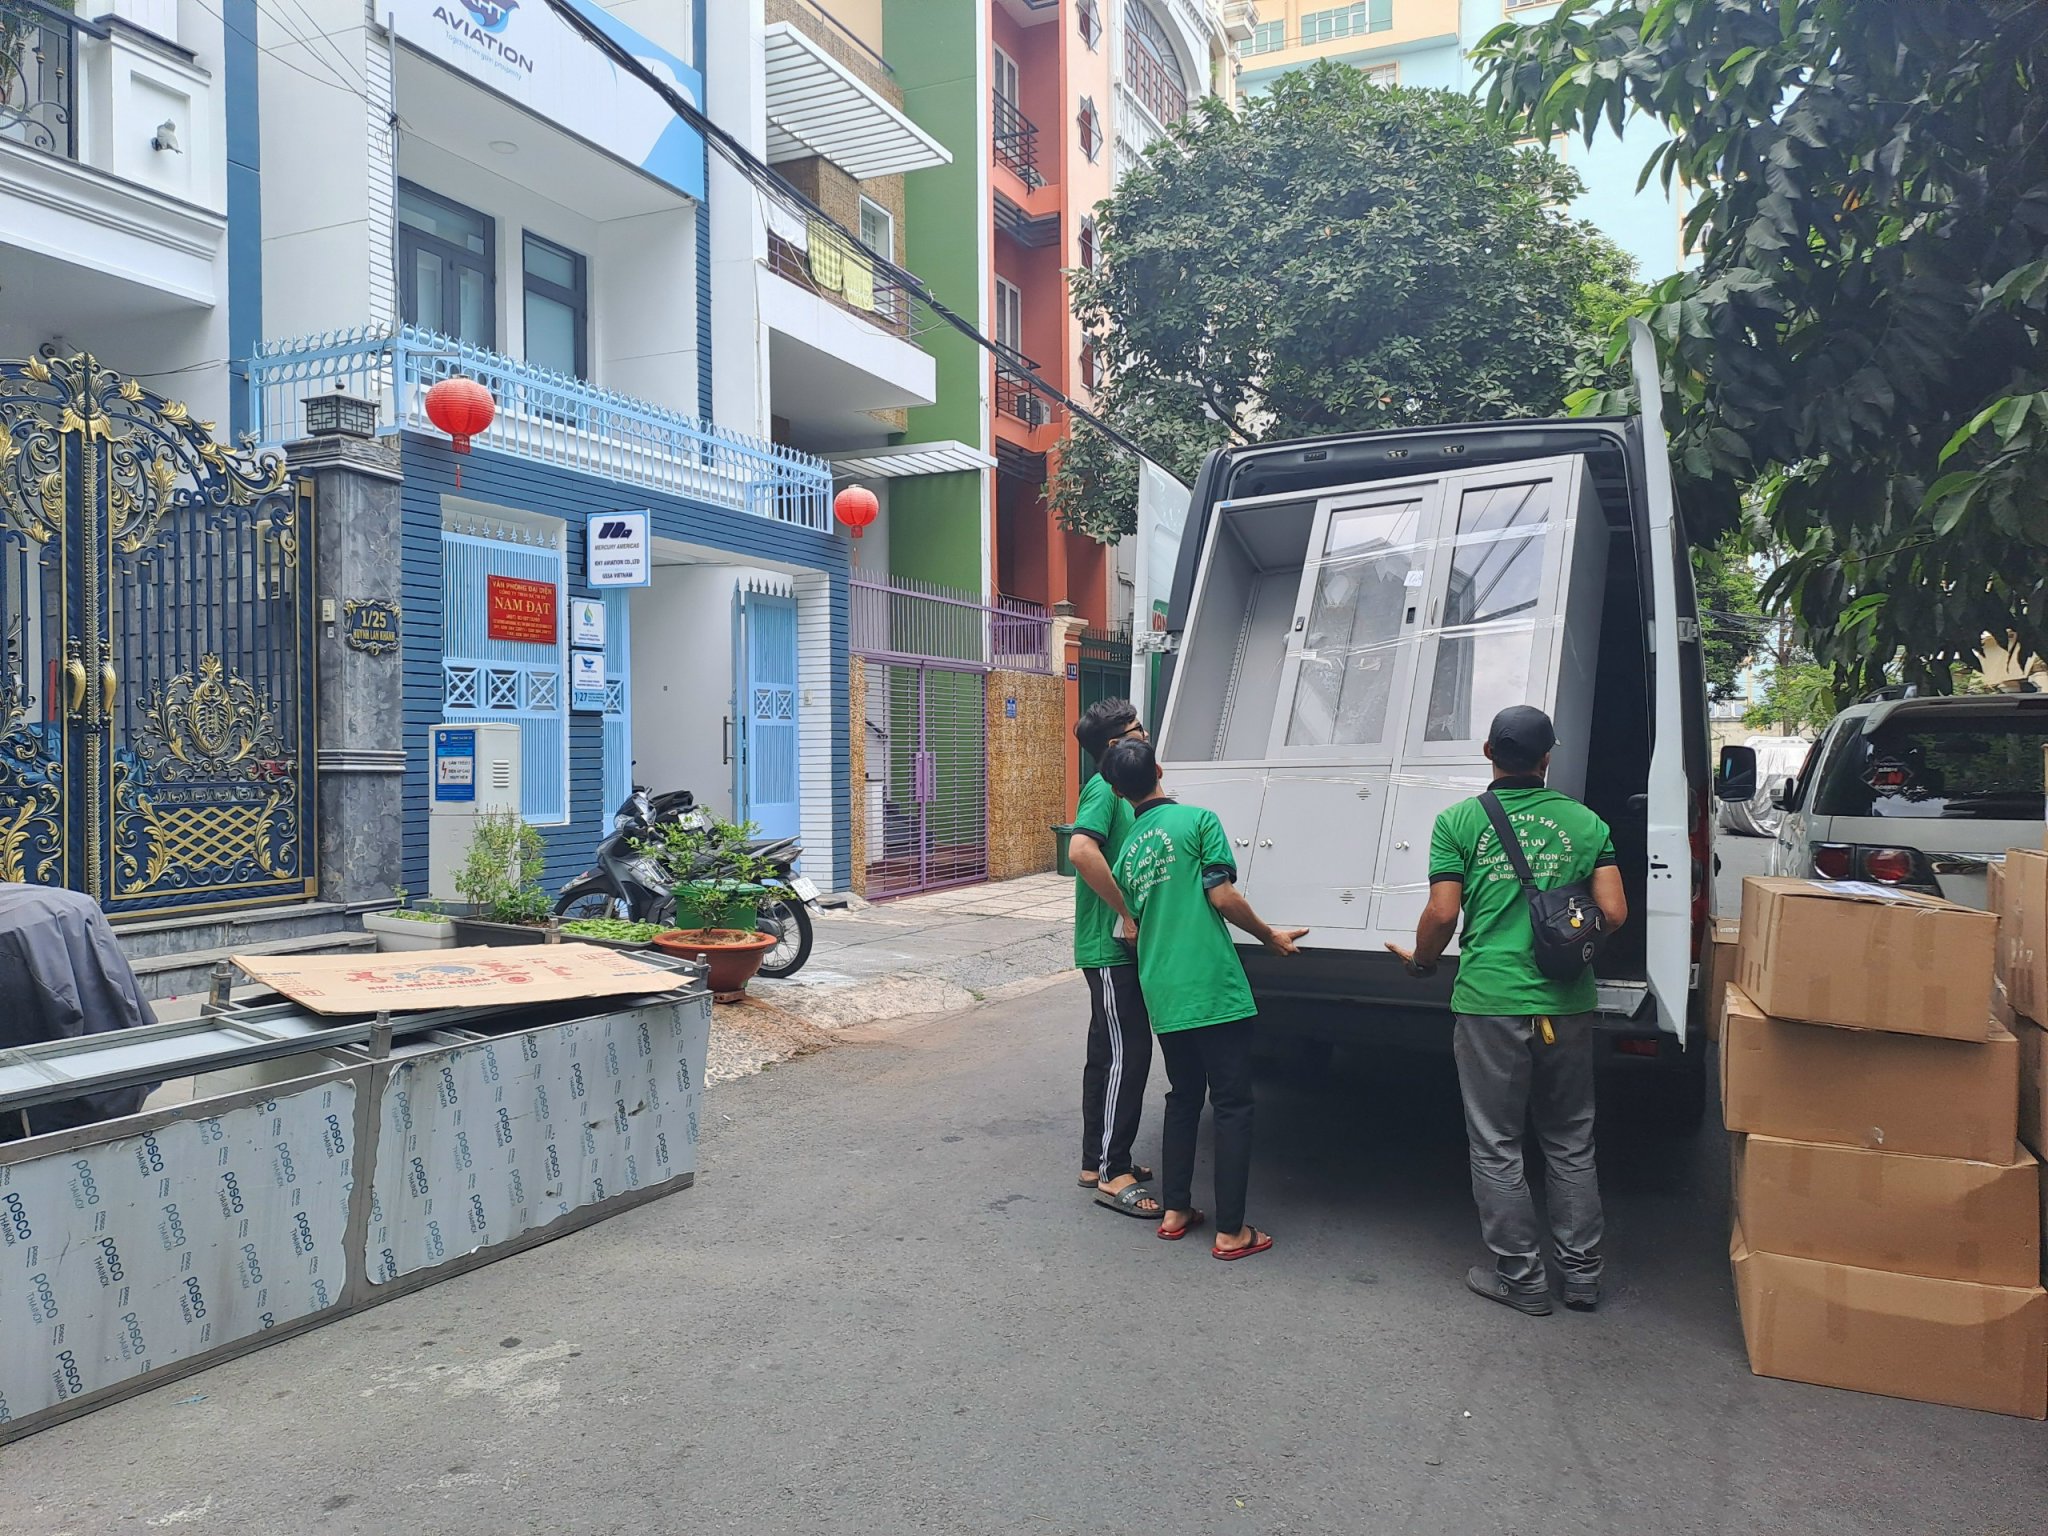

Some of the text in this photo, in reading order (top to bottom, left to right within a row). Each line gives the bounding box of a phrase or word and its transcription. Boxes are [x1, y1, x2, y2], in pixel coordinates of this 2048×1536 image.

[433, 6, 533, 73] AVIATION
[361, 610, 387, 629] 1/25
[495, 596, 551, 617] NAM ĐẠT
[1477, 832, 1491, 857] TAXI
[1510, 813, 1535, 822] 24H
[1520, 828, 1528, 837] &
[639, 1022, 652, 1055] posco
[485, 1044, 500, 1081] posco
[607, 1042, 619, 1075] posco
[679, 1058, 691, 1090] posco
[440, 1067, 458, 1105] posco
[571, 1063, 585, 1097] posco
[648, 1078, 660, 1110] posco
[395, 1091, 413, 1130] posco
[535, 1084, 550, 1120] posco
[325, 1114, 345, 1154] posco
[496, 1107, 513, 1144] posco
[134, 1145, 152, 1180] THAINOX
[275, 1142, 297, 1184] posco
[455, 1131, 473, 1168] posco
[546, 1144, 561, 1178] posco
[657, 1133, 669, 1164] posco
[72, 1160, 100, 1205] posco
[410, 1156, 429, 1195] posco
[509, 1168, 525, 1204] posco
[627, 1155, 639, 1187] posco
[217, 1188, 232, 1221] THAINOX
[221, 1171, 244, 1214] posco
[2, 1192, 32, 1240] posco
[161, 1203, 187, 1248] posco
[469, 1194, 486, 1230] posco
[290, 1227, 304, 1258] THAINOX
[293, 1211, 315, 1252] posco
[427, 1221, 444, 1257] posco
[94, 1255, 111, 1289] THAINOX
[97, 1237, 125, 1282] posco
[240, 1243, 263, 1285] posco
[30, 1272, 59, 1319] posco
[180, 1293, 194, 1326] THAINOX
[182, 1276, 207, 1319] posco
[121, 1312, 146, 1356] posco
[52, 1368, 69, 1402] THAINOX
[55, 1350, 83, 1394] posco
